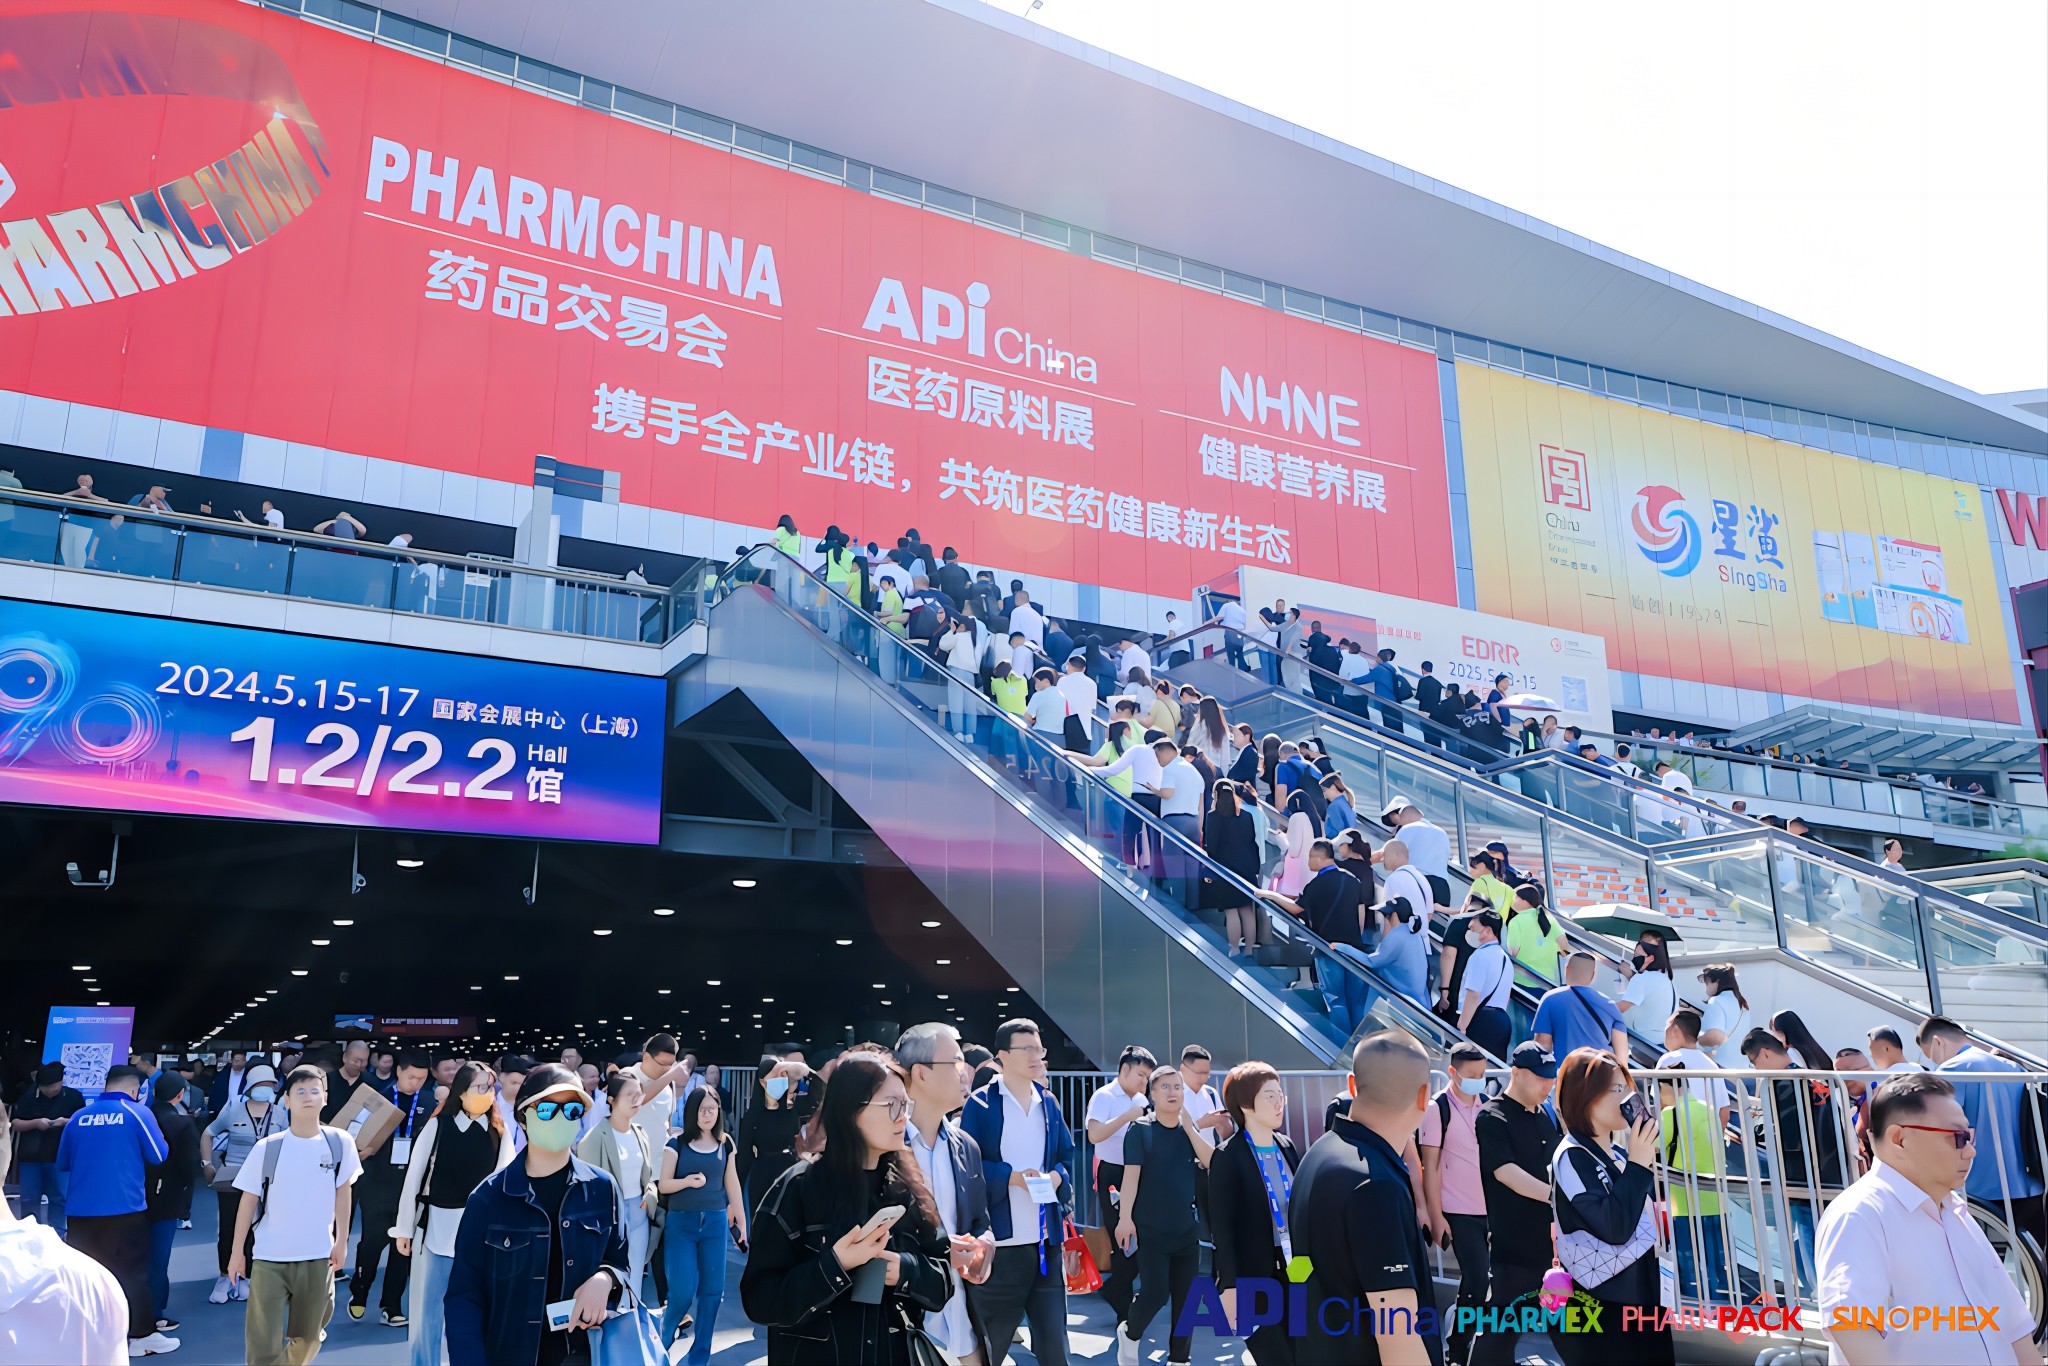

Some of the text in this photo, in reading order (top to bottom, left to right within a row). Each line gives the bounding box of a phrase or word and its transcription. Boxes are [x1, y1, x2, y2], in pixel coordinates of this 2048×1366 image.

[366, 136, 783, 307] PHARMCHINA
[425, 249, 728, 369] 药品交易会
[994, 327, 1098, 384] China
[868, 355, 1095, 450] 医药原料展
[1220, 366, 1362, 447] NHNE
[1199, 433, 1387, 514] 健康营养展
[1461, 634, 1520, 667] EDRR
[156, 661, 419, 717] 2024.5.15-17
[230, 716, 516, 801] 1.2/2.2
[526, 766, 564, 805] 馆
[528, 743, 568, 764] Hall
[78, 1112, 124, 1127] CHINA
